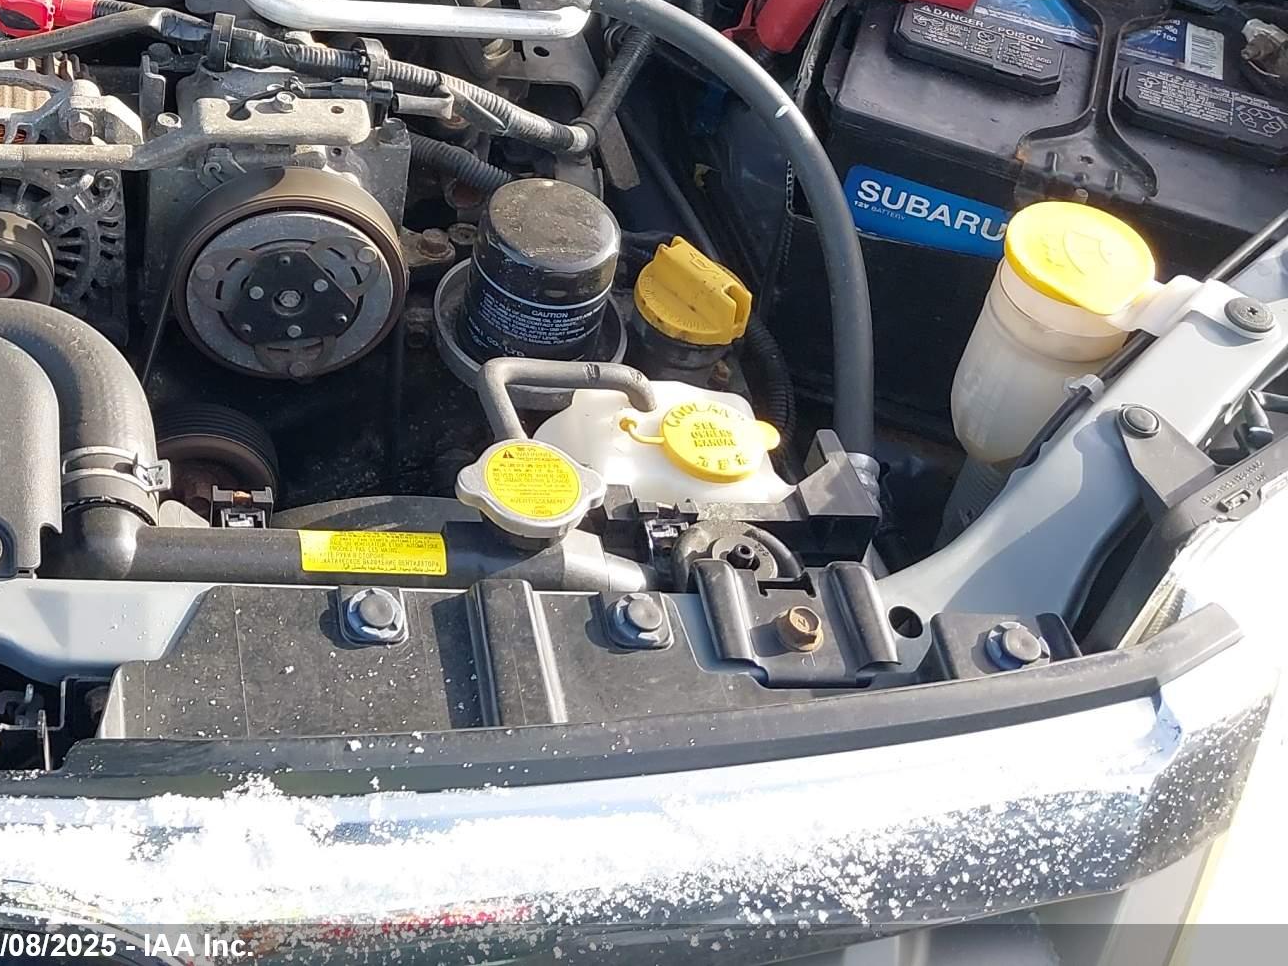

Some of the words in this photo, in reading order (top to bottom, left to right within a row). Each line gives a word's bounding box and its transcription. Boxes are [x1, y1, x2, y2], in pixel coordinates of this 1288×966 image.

[933, 7, 985, 29] DANGER
[997, 26, 1045, 45] POISON
[853, 199, 870, 209] 12V
[870, 205, 907, 221] BATTERY
[857, 180, 1007, 241] SUBARU
[526, 319, 554, 328] CONTACT
[531, 309, 569, 319] CAUTION
